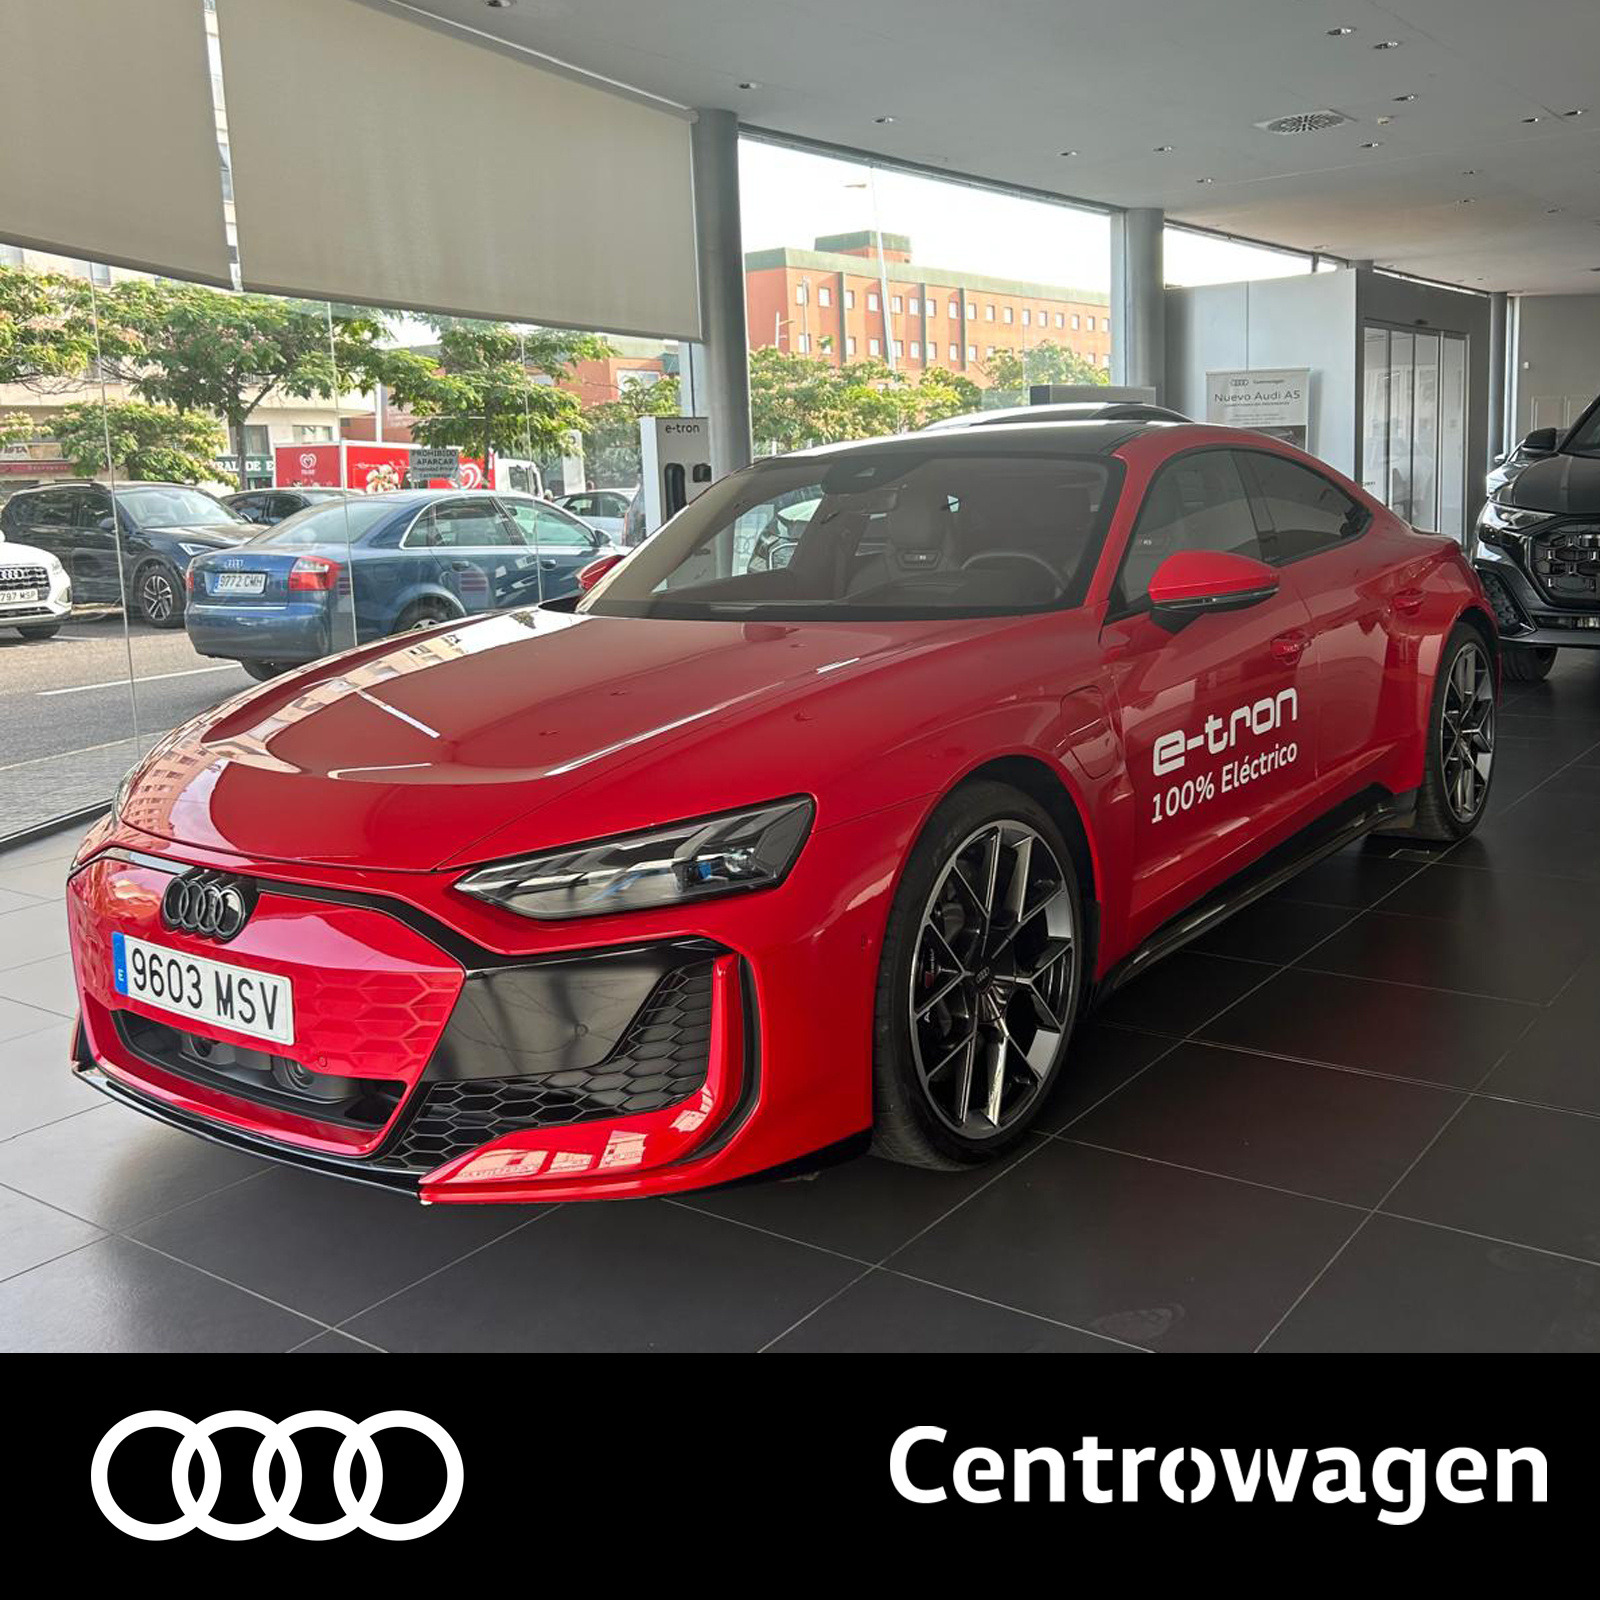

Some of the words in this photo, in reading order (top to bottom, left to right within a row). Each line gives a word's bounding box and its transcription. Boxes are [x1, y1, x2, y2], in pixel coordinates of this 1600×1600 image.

[1214, 393, 1251, 402] Nuevo
[1254, 391, 1281, 401] Audi
[1284, 390, 1301, 400] A5
[665, 423, 700, 434] e-tron
[411, 449, 457, 457] PROHIBIDO
[212, 460, 240, 472] RAL
[245, 460, 261, 472] DE
[220, 575, 242, 588] 9772
[1152, 687, 1298, 777] e-tron
[1151, 771, 1215, 824] 100%
[1220, 742, 1298, 794] Eléctrico
[131, 947, 203, 1009] 9603
[214, 970, 278, 1031] MSV
